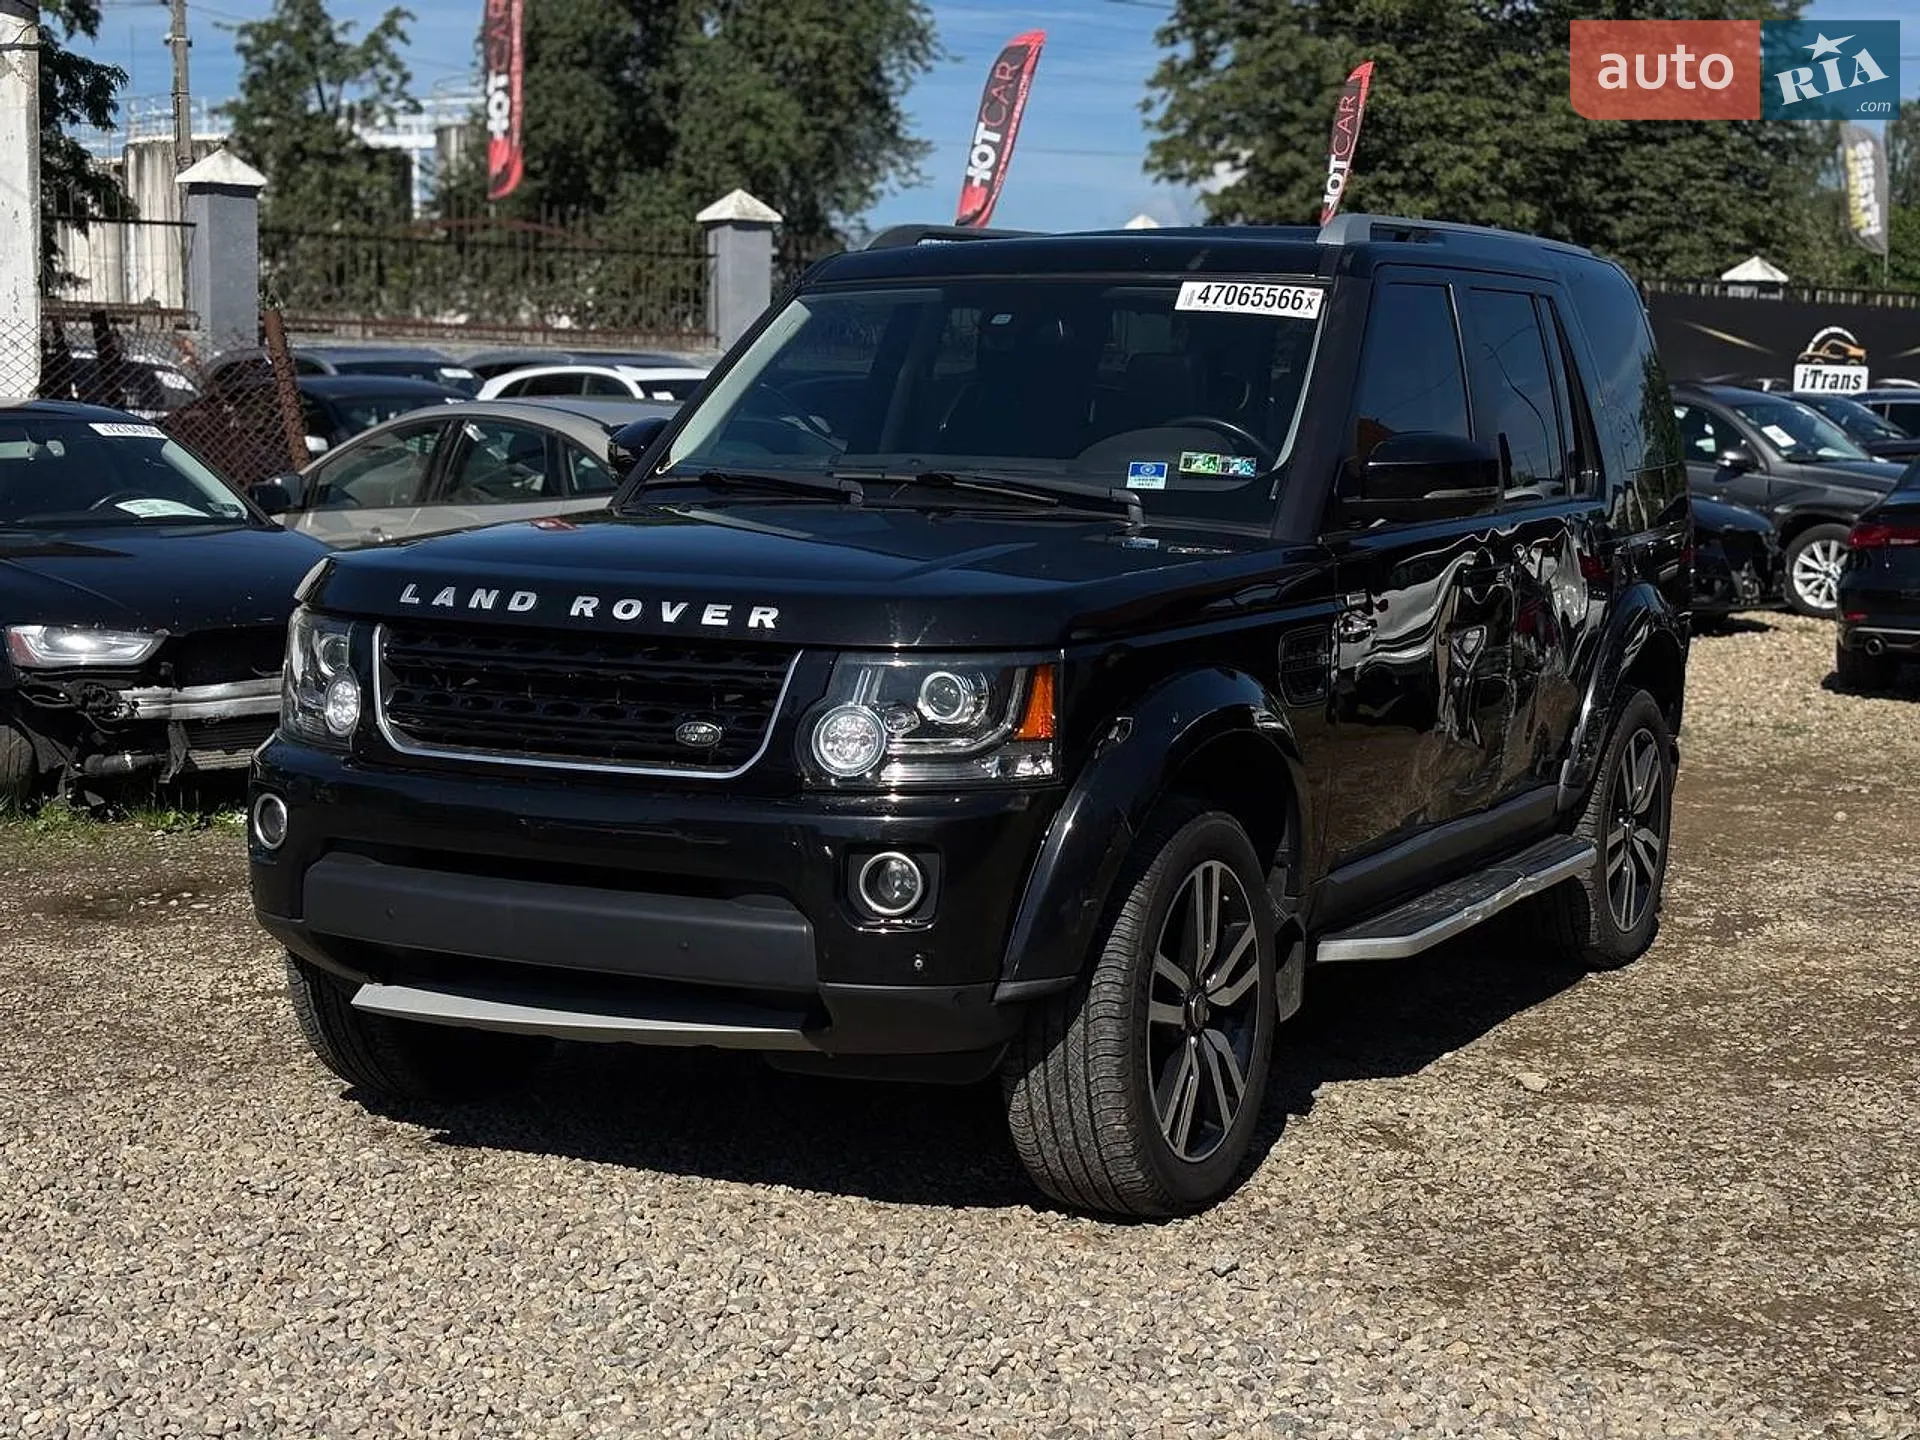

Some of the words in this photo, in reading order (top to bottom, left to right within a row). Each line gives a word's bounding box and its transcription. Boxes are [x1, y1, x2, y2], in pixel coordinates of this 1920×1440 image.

[1801, 367, 1862, 391] iTrans
[399, 583, 538, 612] LAND
[569, 595, 780, 630] ROVER
